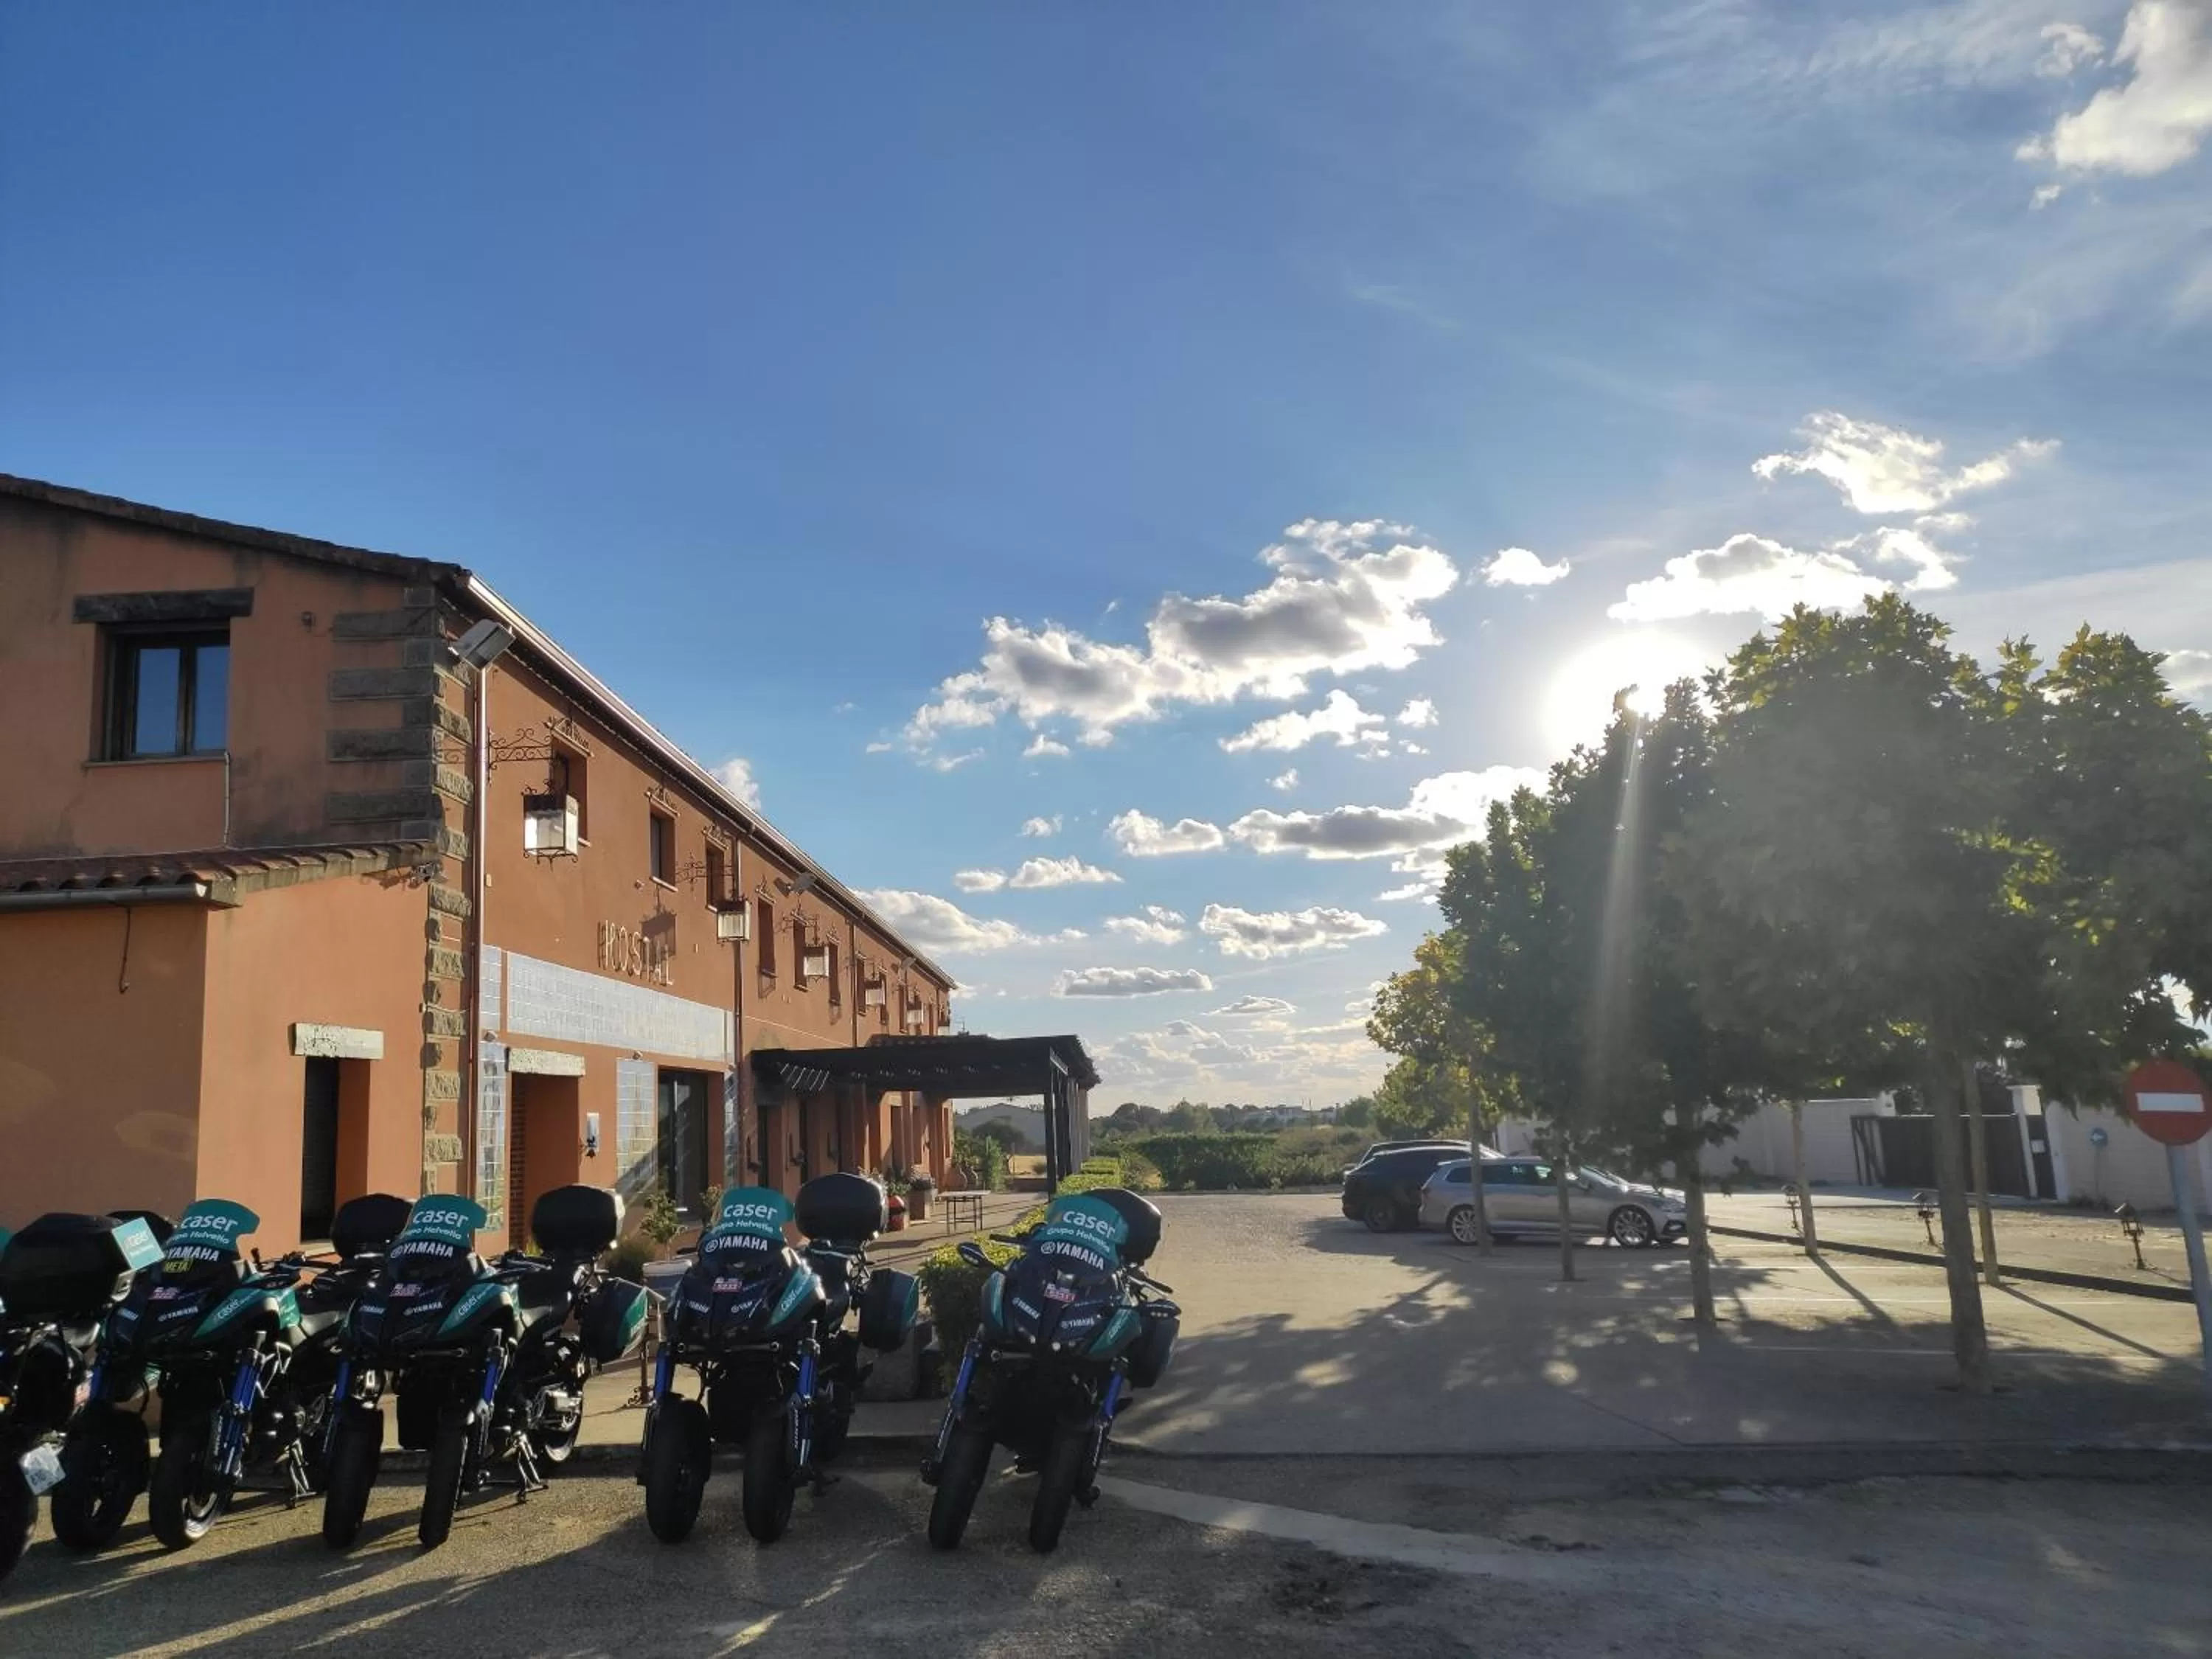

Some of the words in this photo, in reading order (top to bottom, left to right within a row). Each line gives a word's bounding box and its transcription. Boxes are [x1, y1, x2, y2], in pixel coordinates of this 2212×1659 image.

[412, 1210, 469, 1228] caser
[724, 1203, 778, 1220] caser
[181, 1214, 239, 1232] caser
[1062, 1210, 1116, 1239] caser
[403, 1241, 454, 1259] YAMAHA
[718, 1235, 768, 1251] YAMAHA
[167, 1245, 220, 1262] YAMAHA
[1055, 1241, 1105, 1271] YAMAHA
